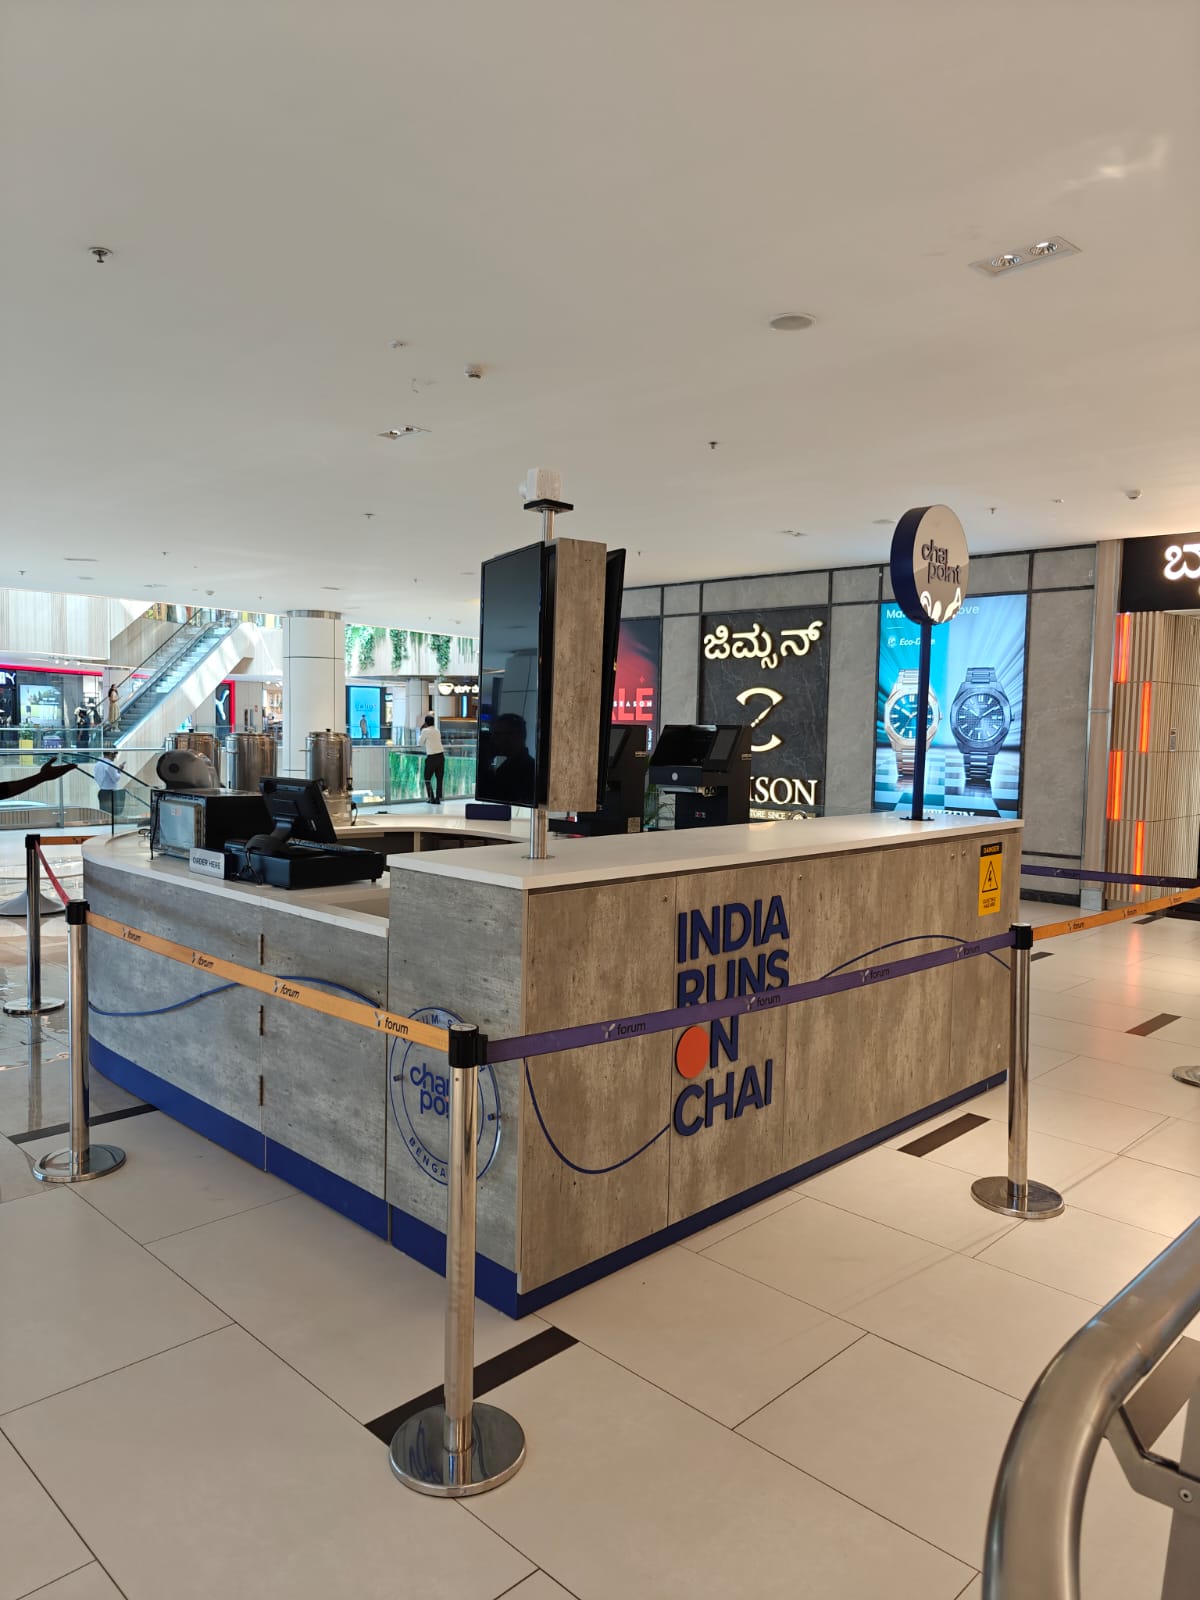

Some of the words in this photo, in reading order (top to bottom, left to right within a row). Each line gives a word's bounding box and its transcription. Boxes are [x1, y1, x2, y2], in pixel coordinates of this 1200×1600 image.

[921, 539, 948, 564] chai
[928, 563, 961, 584] point
[612, 688, 654, 721] LE
[613, 700, 652, 708] SEASON
[750, 776, 818, 806] SON
[750, 808, 766, 818] TORE
[192, 856, 208, 867] ORDER
[208, 859, 221, 870] HERE
[677, 895, 789, 964] INDIA
[677, 949, 789, 1009] RUNS
[869, 967, 890, 981] forum
[279, 983, 300, 1000] forum
[756, 993, 781, 1008] forum
[384, 1016, 409, 1035] forum
[617, 1020, 647, 1036] forum
[420, 1088, 449, 1119] poi
[673, 1059, 773, 1137] CHAI
